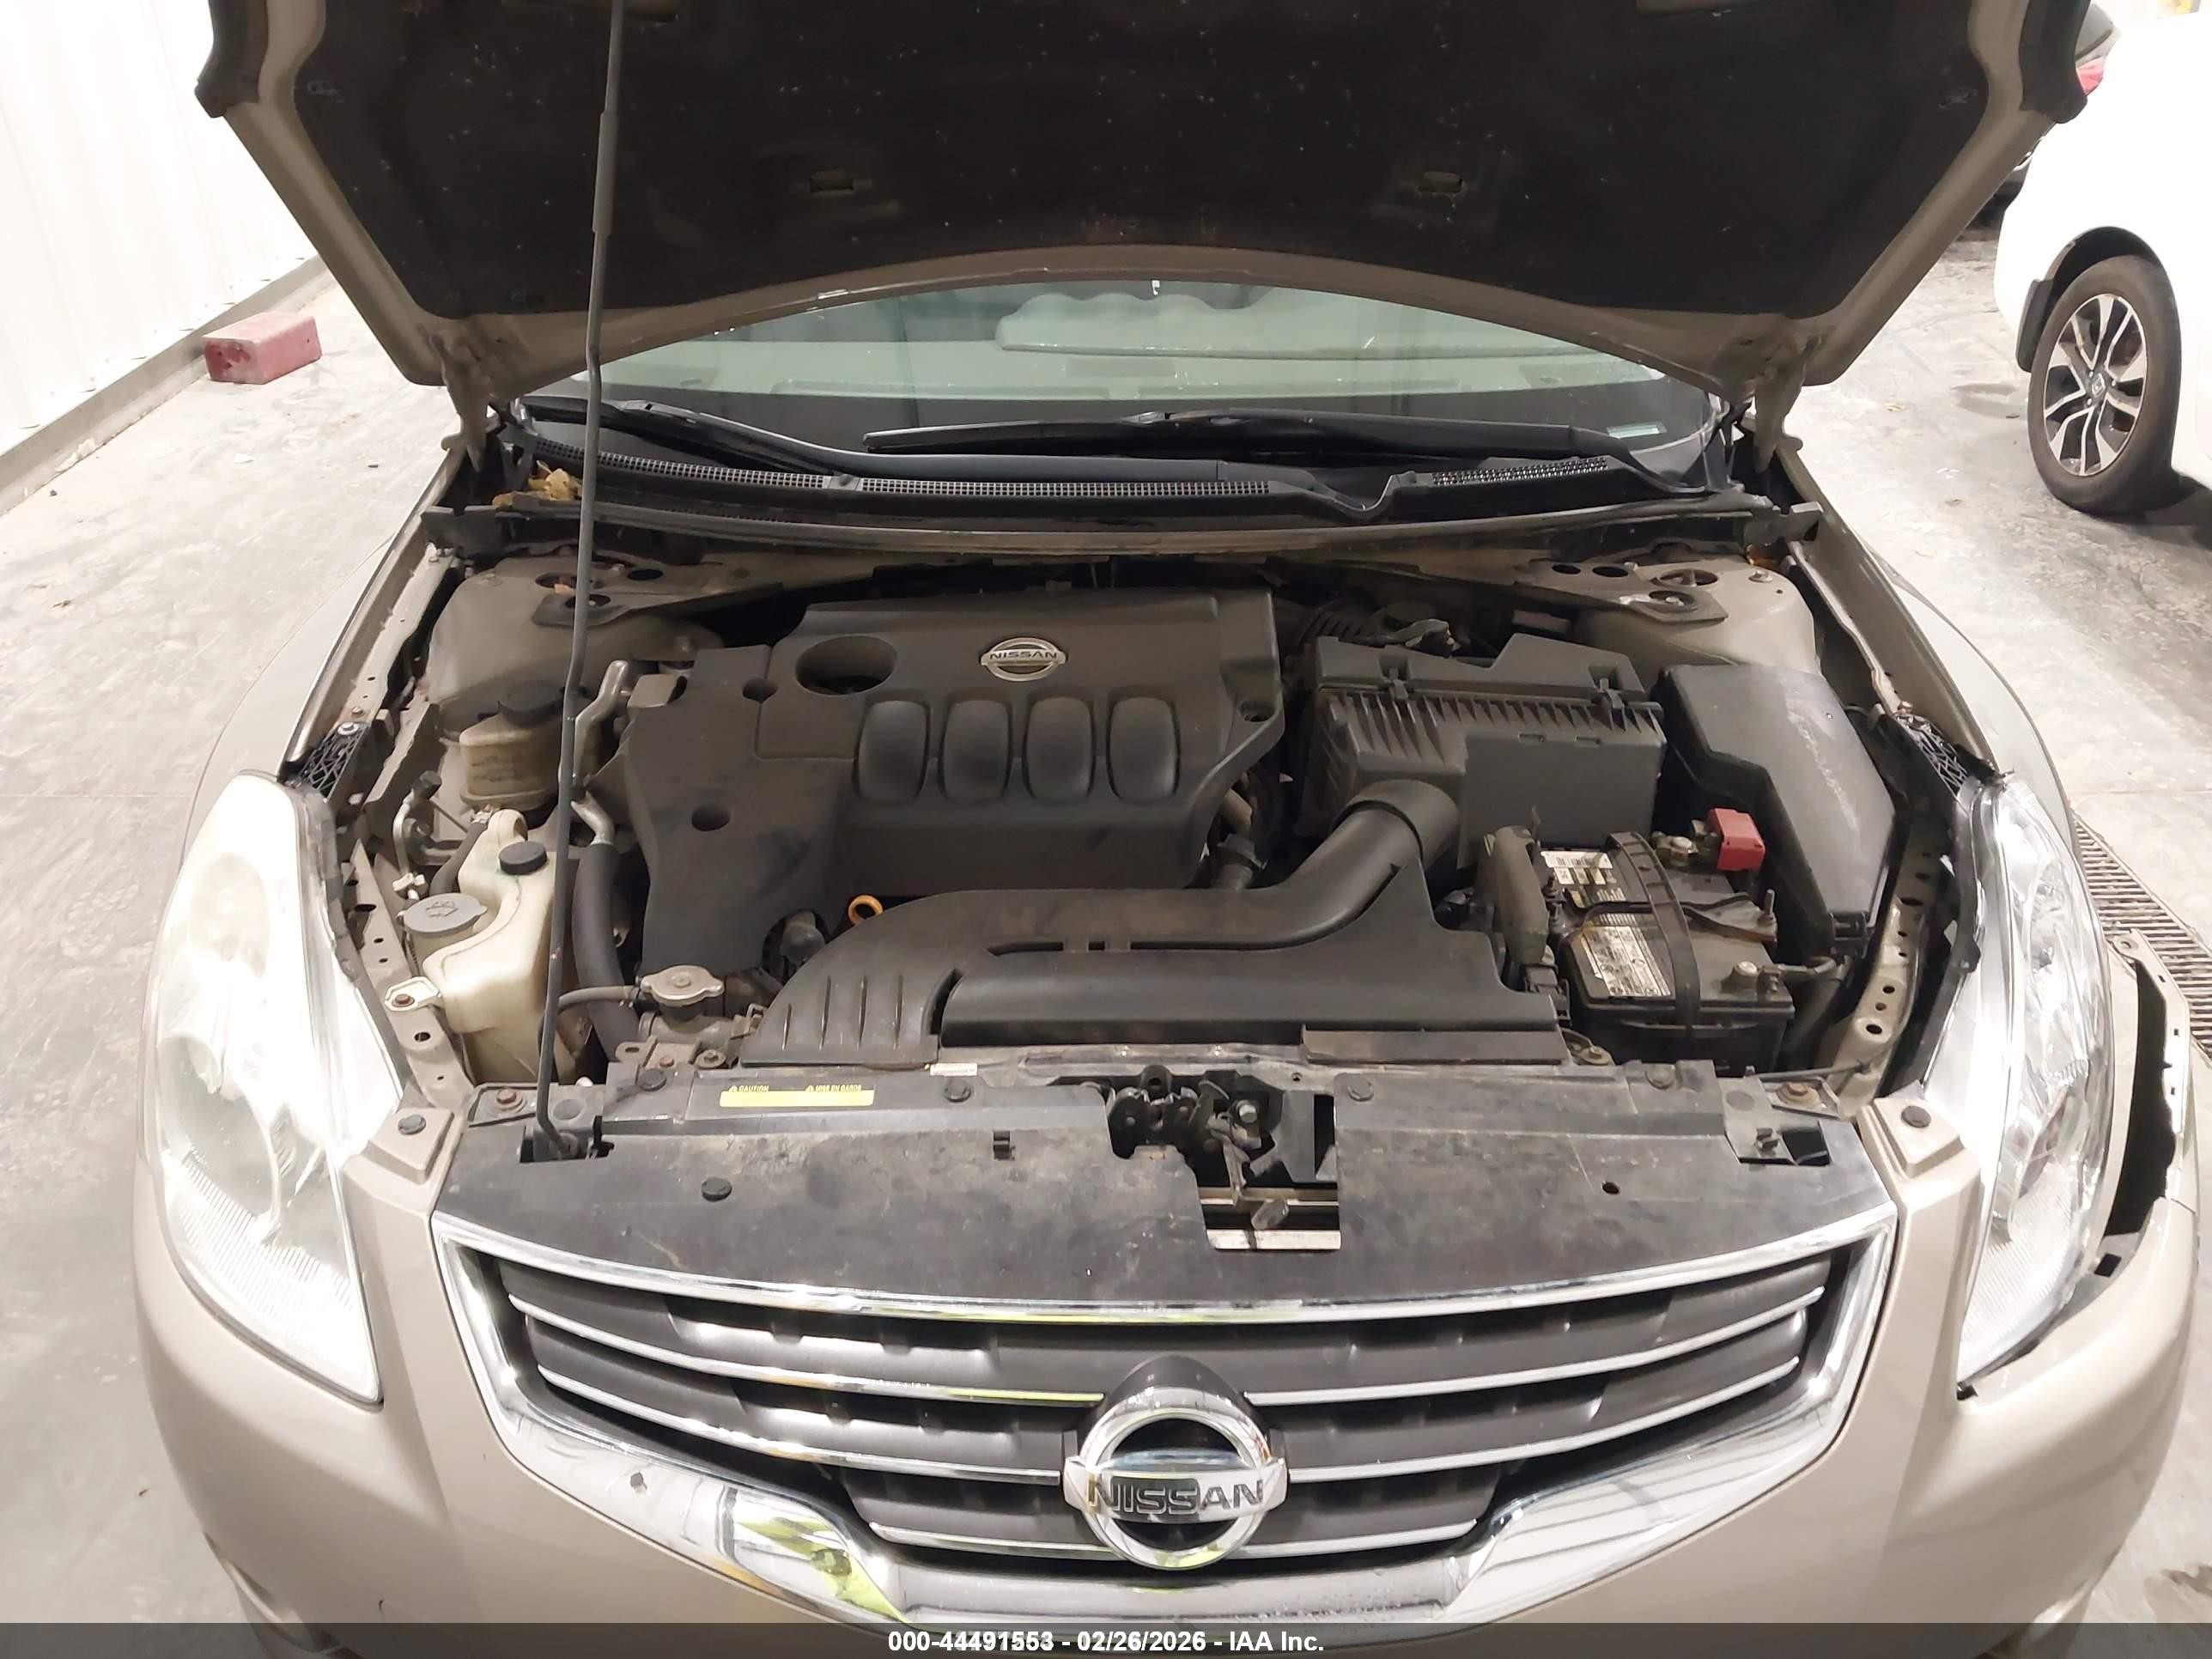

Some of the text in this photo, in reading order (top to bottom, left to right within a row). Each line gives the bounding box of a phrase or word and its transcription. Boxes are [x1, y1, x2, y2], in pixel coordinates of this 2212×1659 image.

[990, 651, 1057, 660] NISSAN
[738, 1084, 769, 1093] CAUTION
[1087, 1474, 1264, 1516] NISSAN
